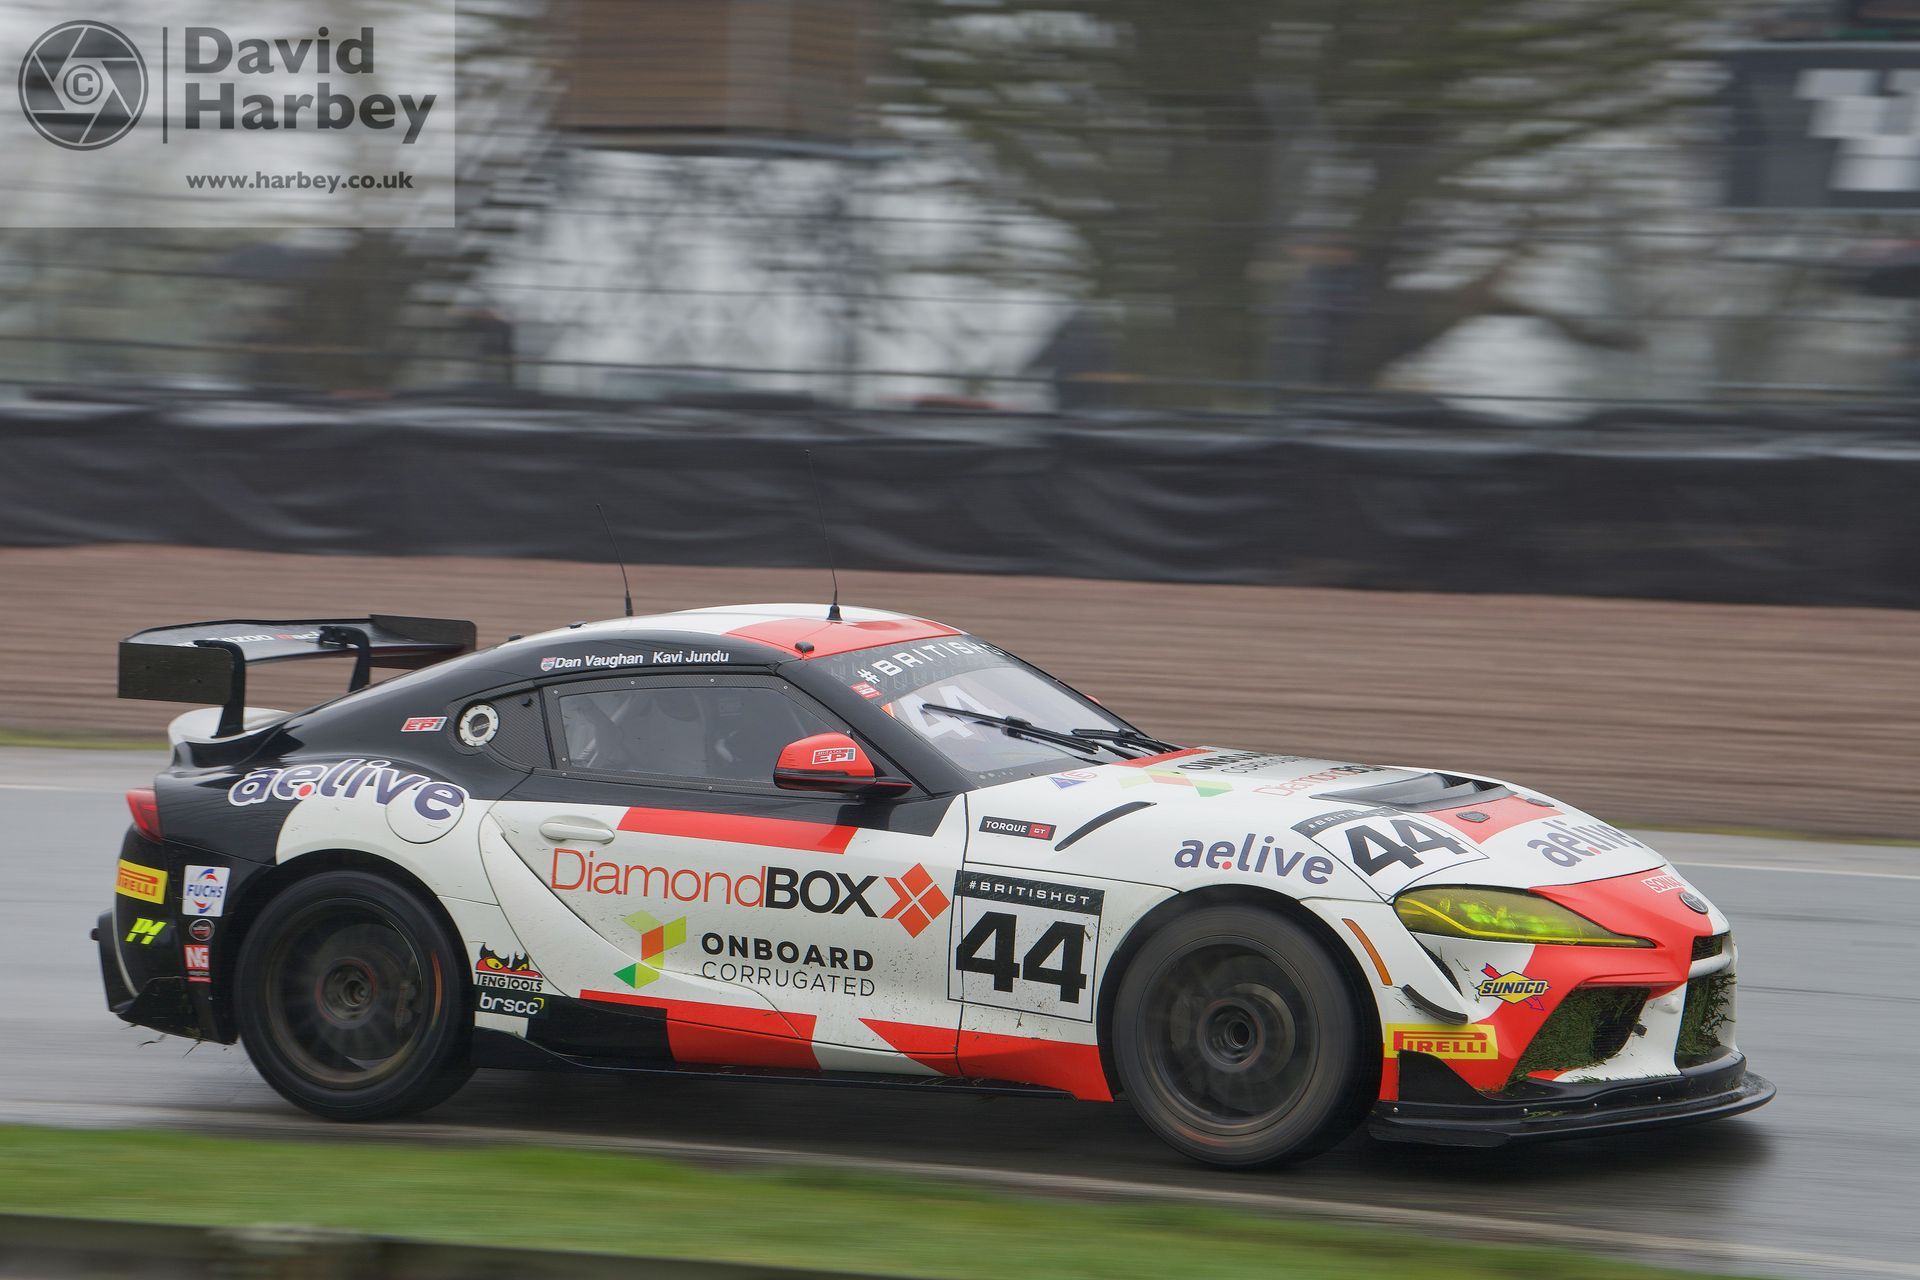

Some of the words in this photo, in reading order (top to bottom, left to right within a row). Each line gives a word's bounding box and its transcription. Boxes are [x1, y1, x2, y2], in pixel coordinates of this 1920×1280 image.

[554, 656, 582, 669] Dan
[584, 653, 644, 668] Vaughan
[652, 651, 682, 664] Kavi
[685, 650, 730, 663] Jundu
[986, 820, 1028, 833] TORQUE
[1345, 819, 1469, 876] 44
[186, 884, 224, 898] FUCHS
[550, 847, 879, 919] DiamondBOX
[969, 880, 1090, 905] #BRITISHGT
[701, 932, 875, 972] ONBOARD
[956, 911, 1088, 1004] 44
[702, 961, 876, 998] CORRUGATED
[1481, 981, 1546, 994] SUNOCO
[479, 991, 539, 1015] brscc
[1393, 1030, 1488, 1054] PIRELLI
